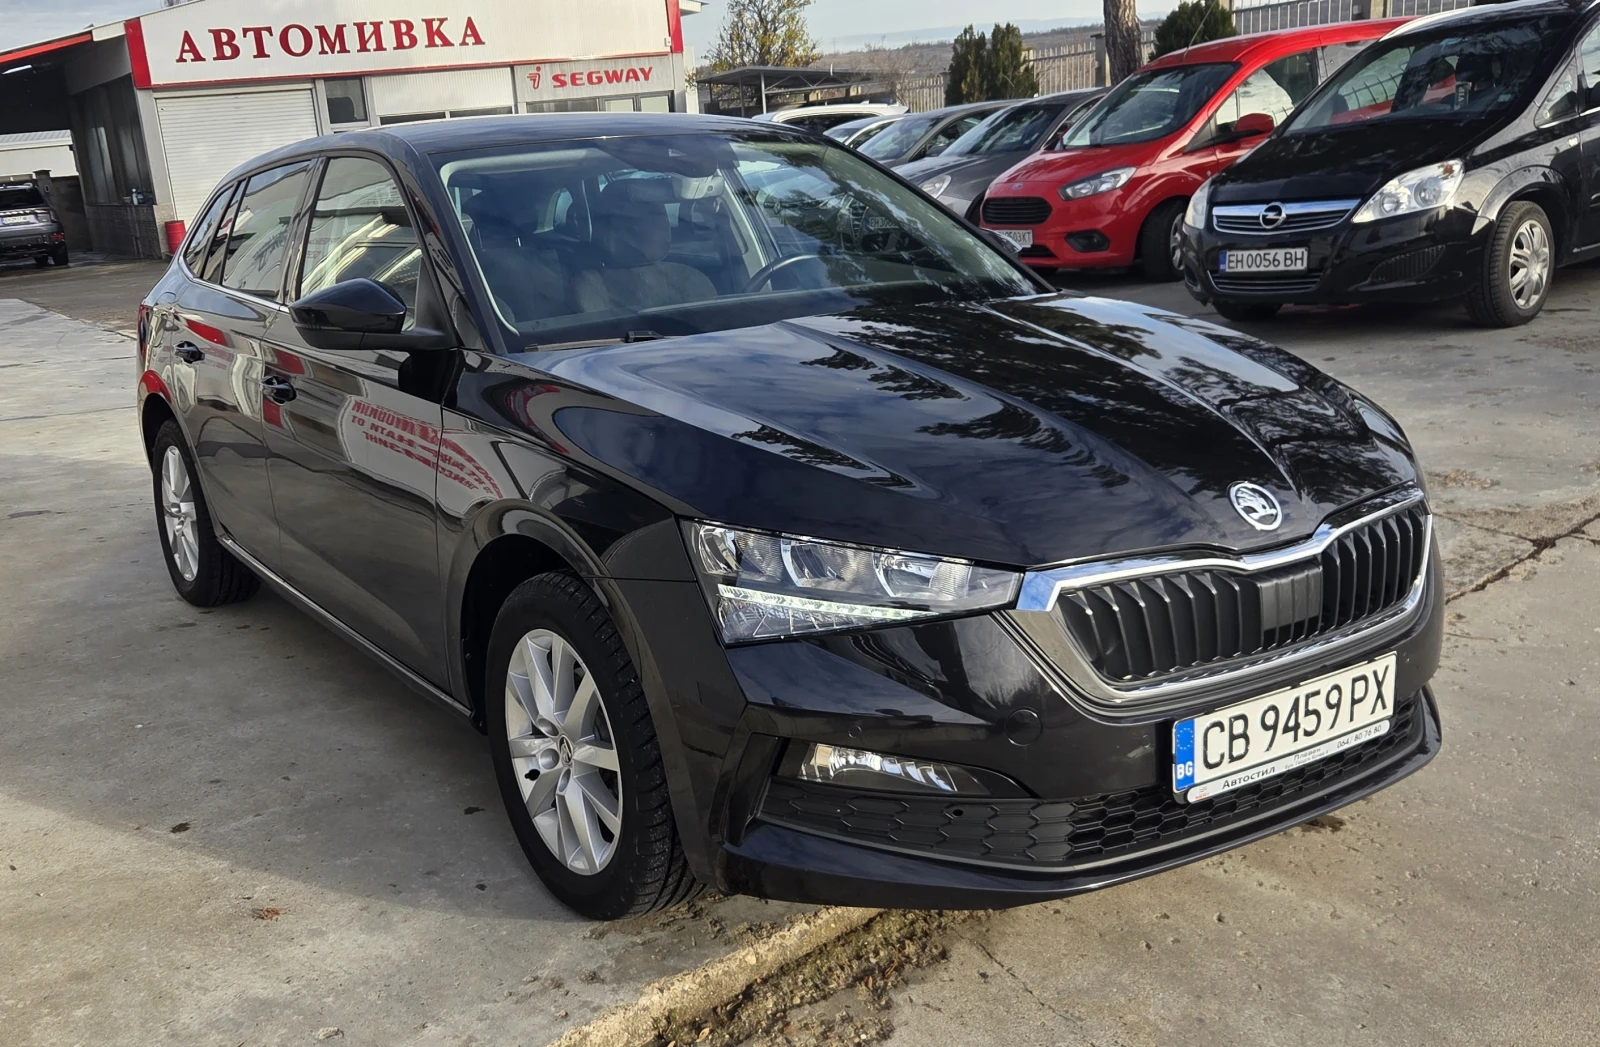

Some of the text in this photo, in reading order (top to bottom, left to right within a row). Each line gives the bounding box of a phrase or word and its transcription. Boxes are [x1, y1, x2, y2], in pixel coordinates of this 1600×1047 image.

[175, 16, 486, 63] АВТОМИВКА
[551, 66, 653, 89] SEGWAY
[1227, 250, 1304, 269] EH 0056 BH
[1202, 664, 1390, 770] CB 9459 PX
[1176, 761, 1193, 780] BG
